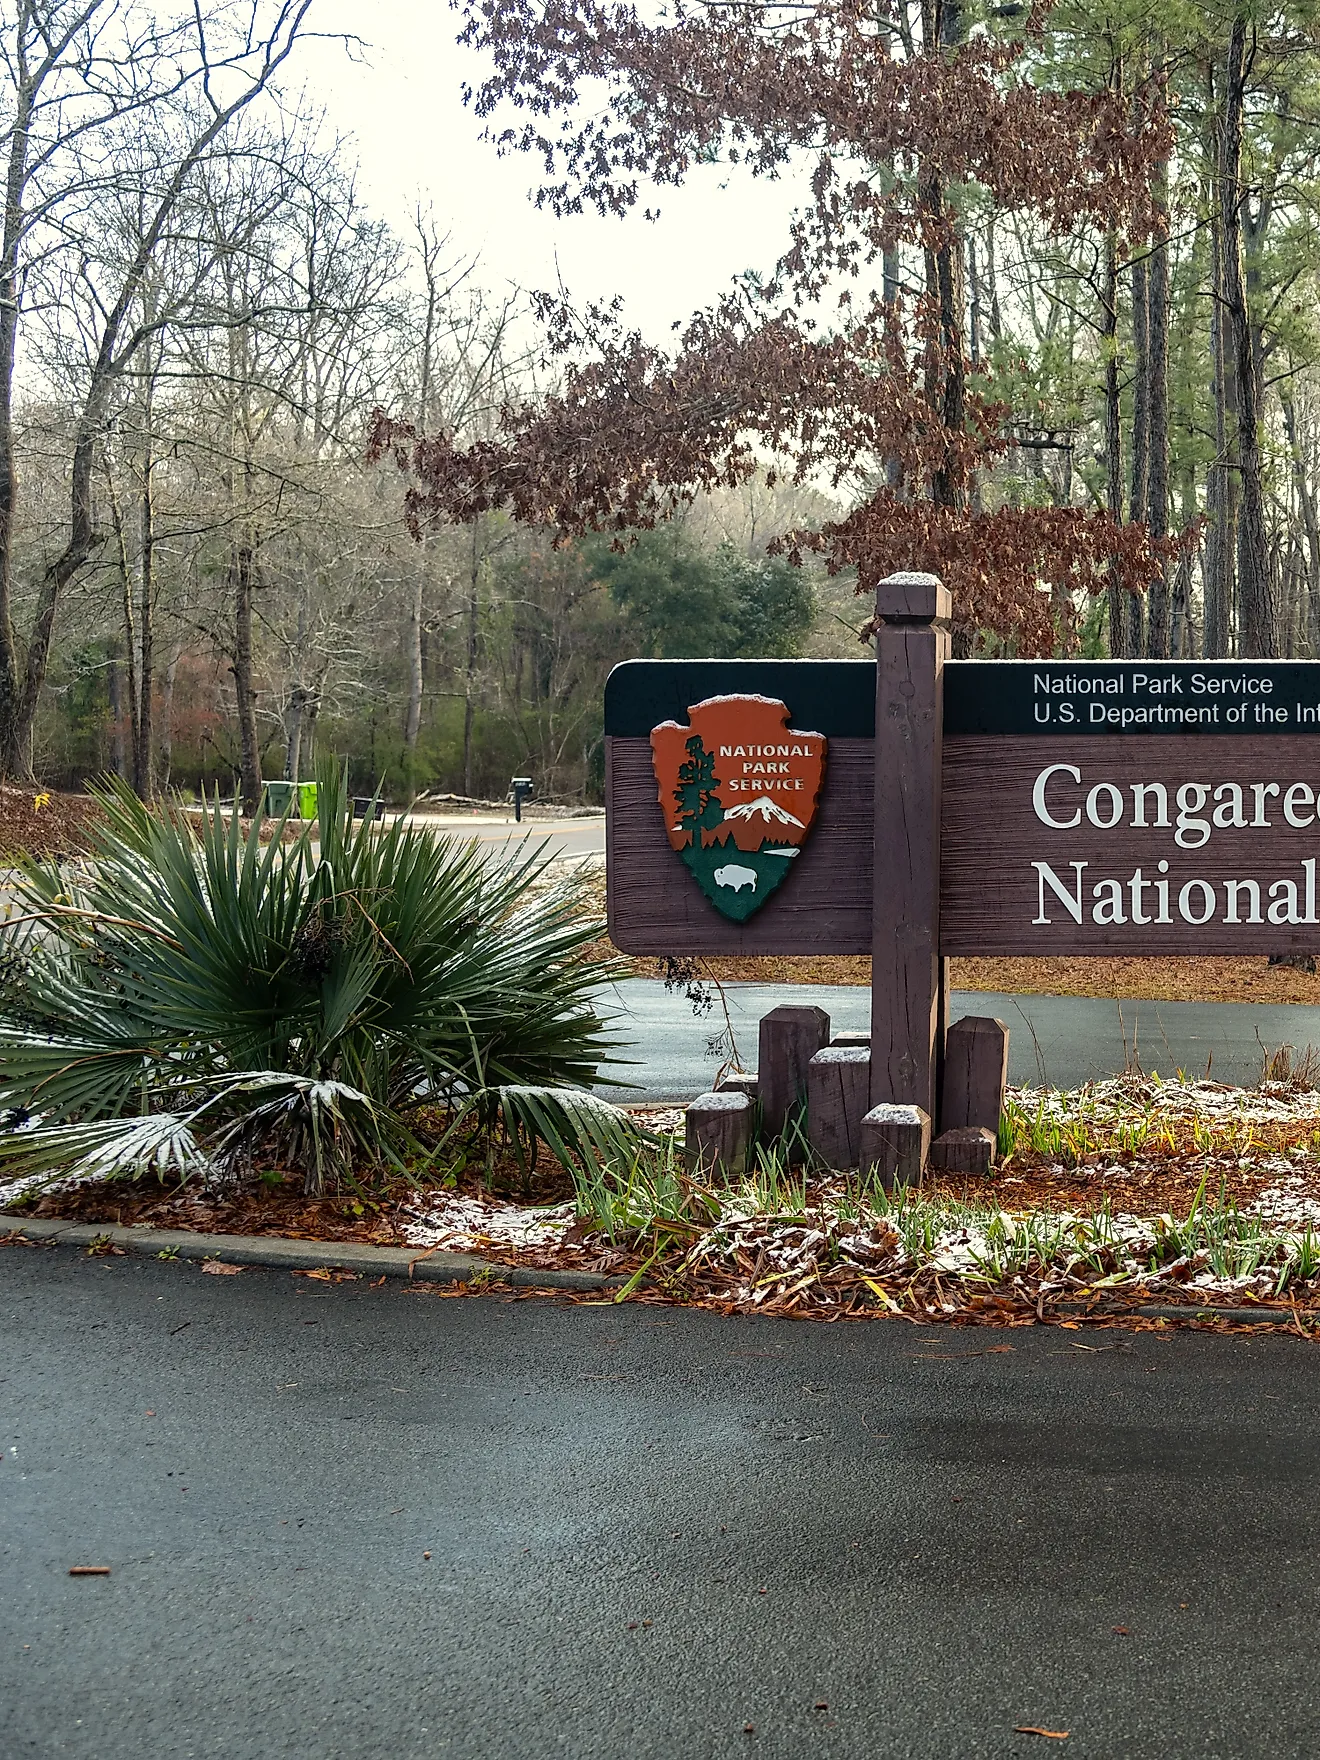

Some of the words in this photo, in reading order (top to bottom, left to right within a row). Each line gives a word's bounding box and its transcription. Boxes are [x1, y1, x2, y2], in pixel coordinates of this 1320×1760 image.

[1033, 673, 1124, 694] National
[1132, 673, 1183, 694] Park
[1190, 673, 1274, 695] Service
[1033, 702, 1082, 723] U.S.
[1089, 702, 1220, 727] Department
[1226, 702, 1248, 723] of
[1254, 702, 1289, 723] the
[719, 745, 814, 757] NATIONAL
[742, 762, 790, 774] PARK
[728, 779, 805, 791] SERVICE
[1030, 858, 1320, 926] National
